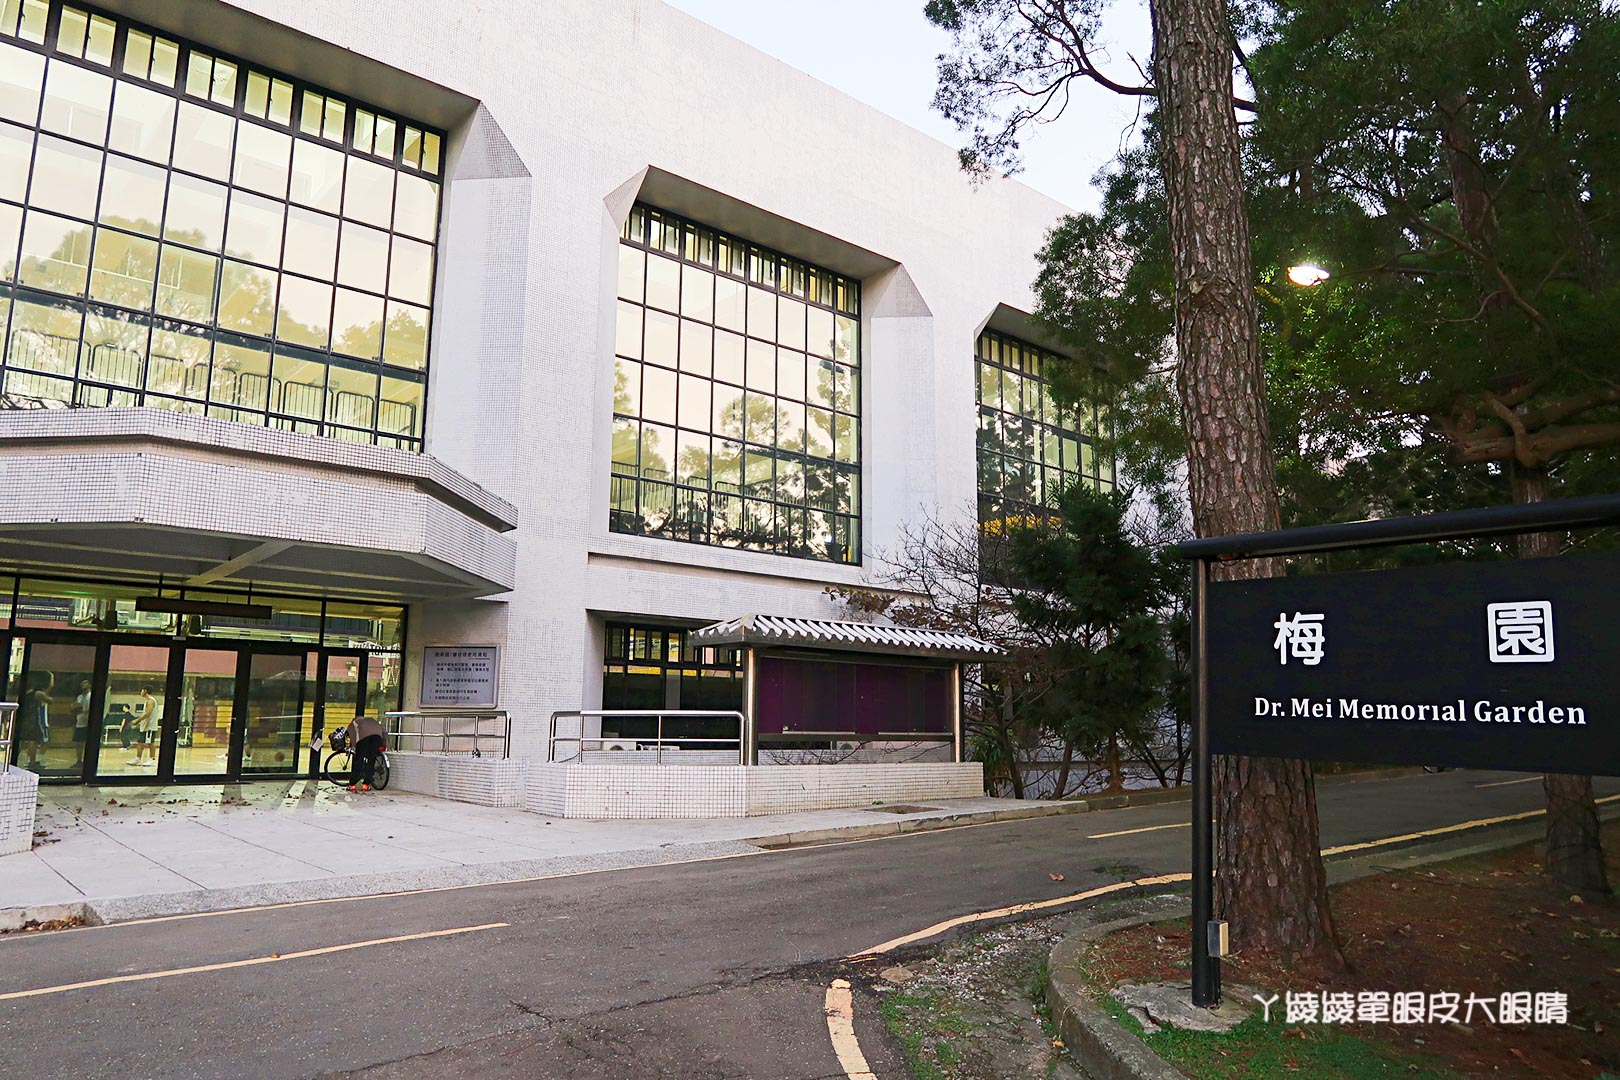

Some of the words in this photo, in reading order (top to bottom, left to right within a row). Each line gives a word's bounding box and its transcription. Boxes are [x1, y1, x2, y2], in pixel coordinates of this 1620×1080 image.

[1254, 697, 1286, 717] Dr.
[1290, 698, 1333, 719] Mei
[1338, 698, 1467, 722] Memorial
[1474, 699, 1587, 725] Garden
